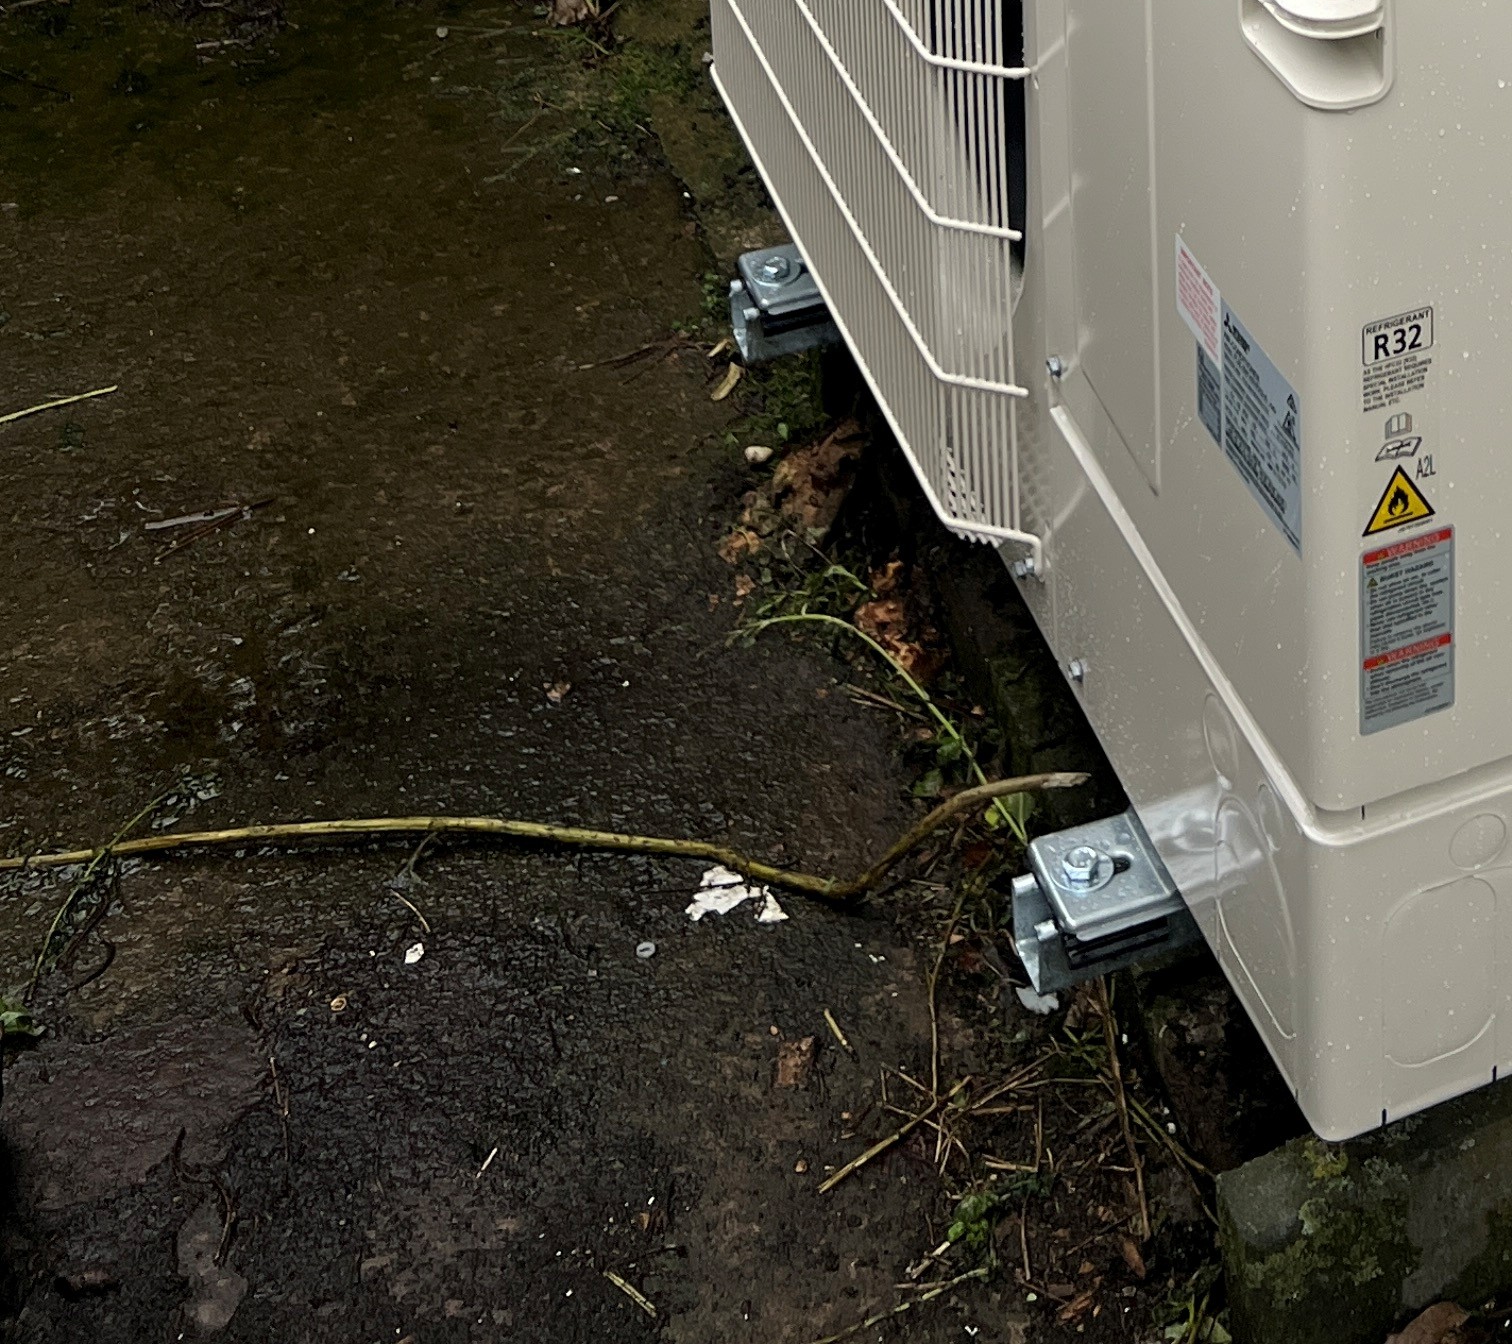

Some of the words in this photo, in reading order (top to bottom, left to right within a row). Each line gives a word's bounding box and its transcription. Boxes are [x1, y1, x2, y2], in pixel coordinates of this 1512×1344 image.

[1365, 309, 1430, 335] REFRIGERANT
[1373, 323, 1423, 361] R32
[1415, 453, 1437, 481] A2L
